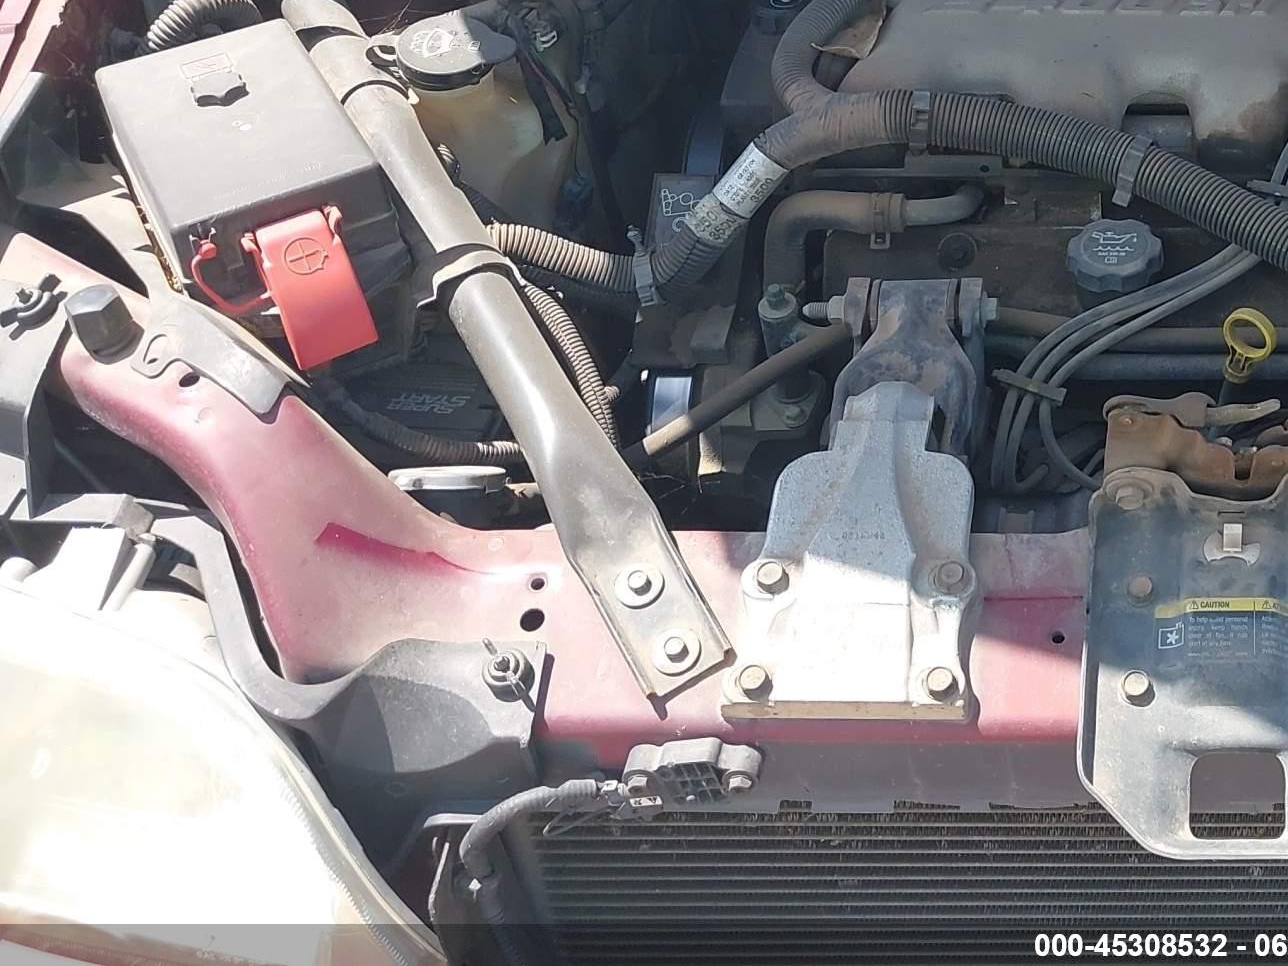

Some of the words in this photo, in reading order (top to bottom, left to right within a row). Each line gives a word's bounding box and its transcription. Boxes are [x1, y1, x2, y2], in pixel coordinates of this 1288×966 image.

[390, 393, 472, 408] START
[386, 401, 454, 414] SUPER
[1200, 601, 1230, 609] CAUTION
